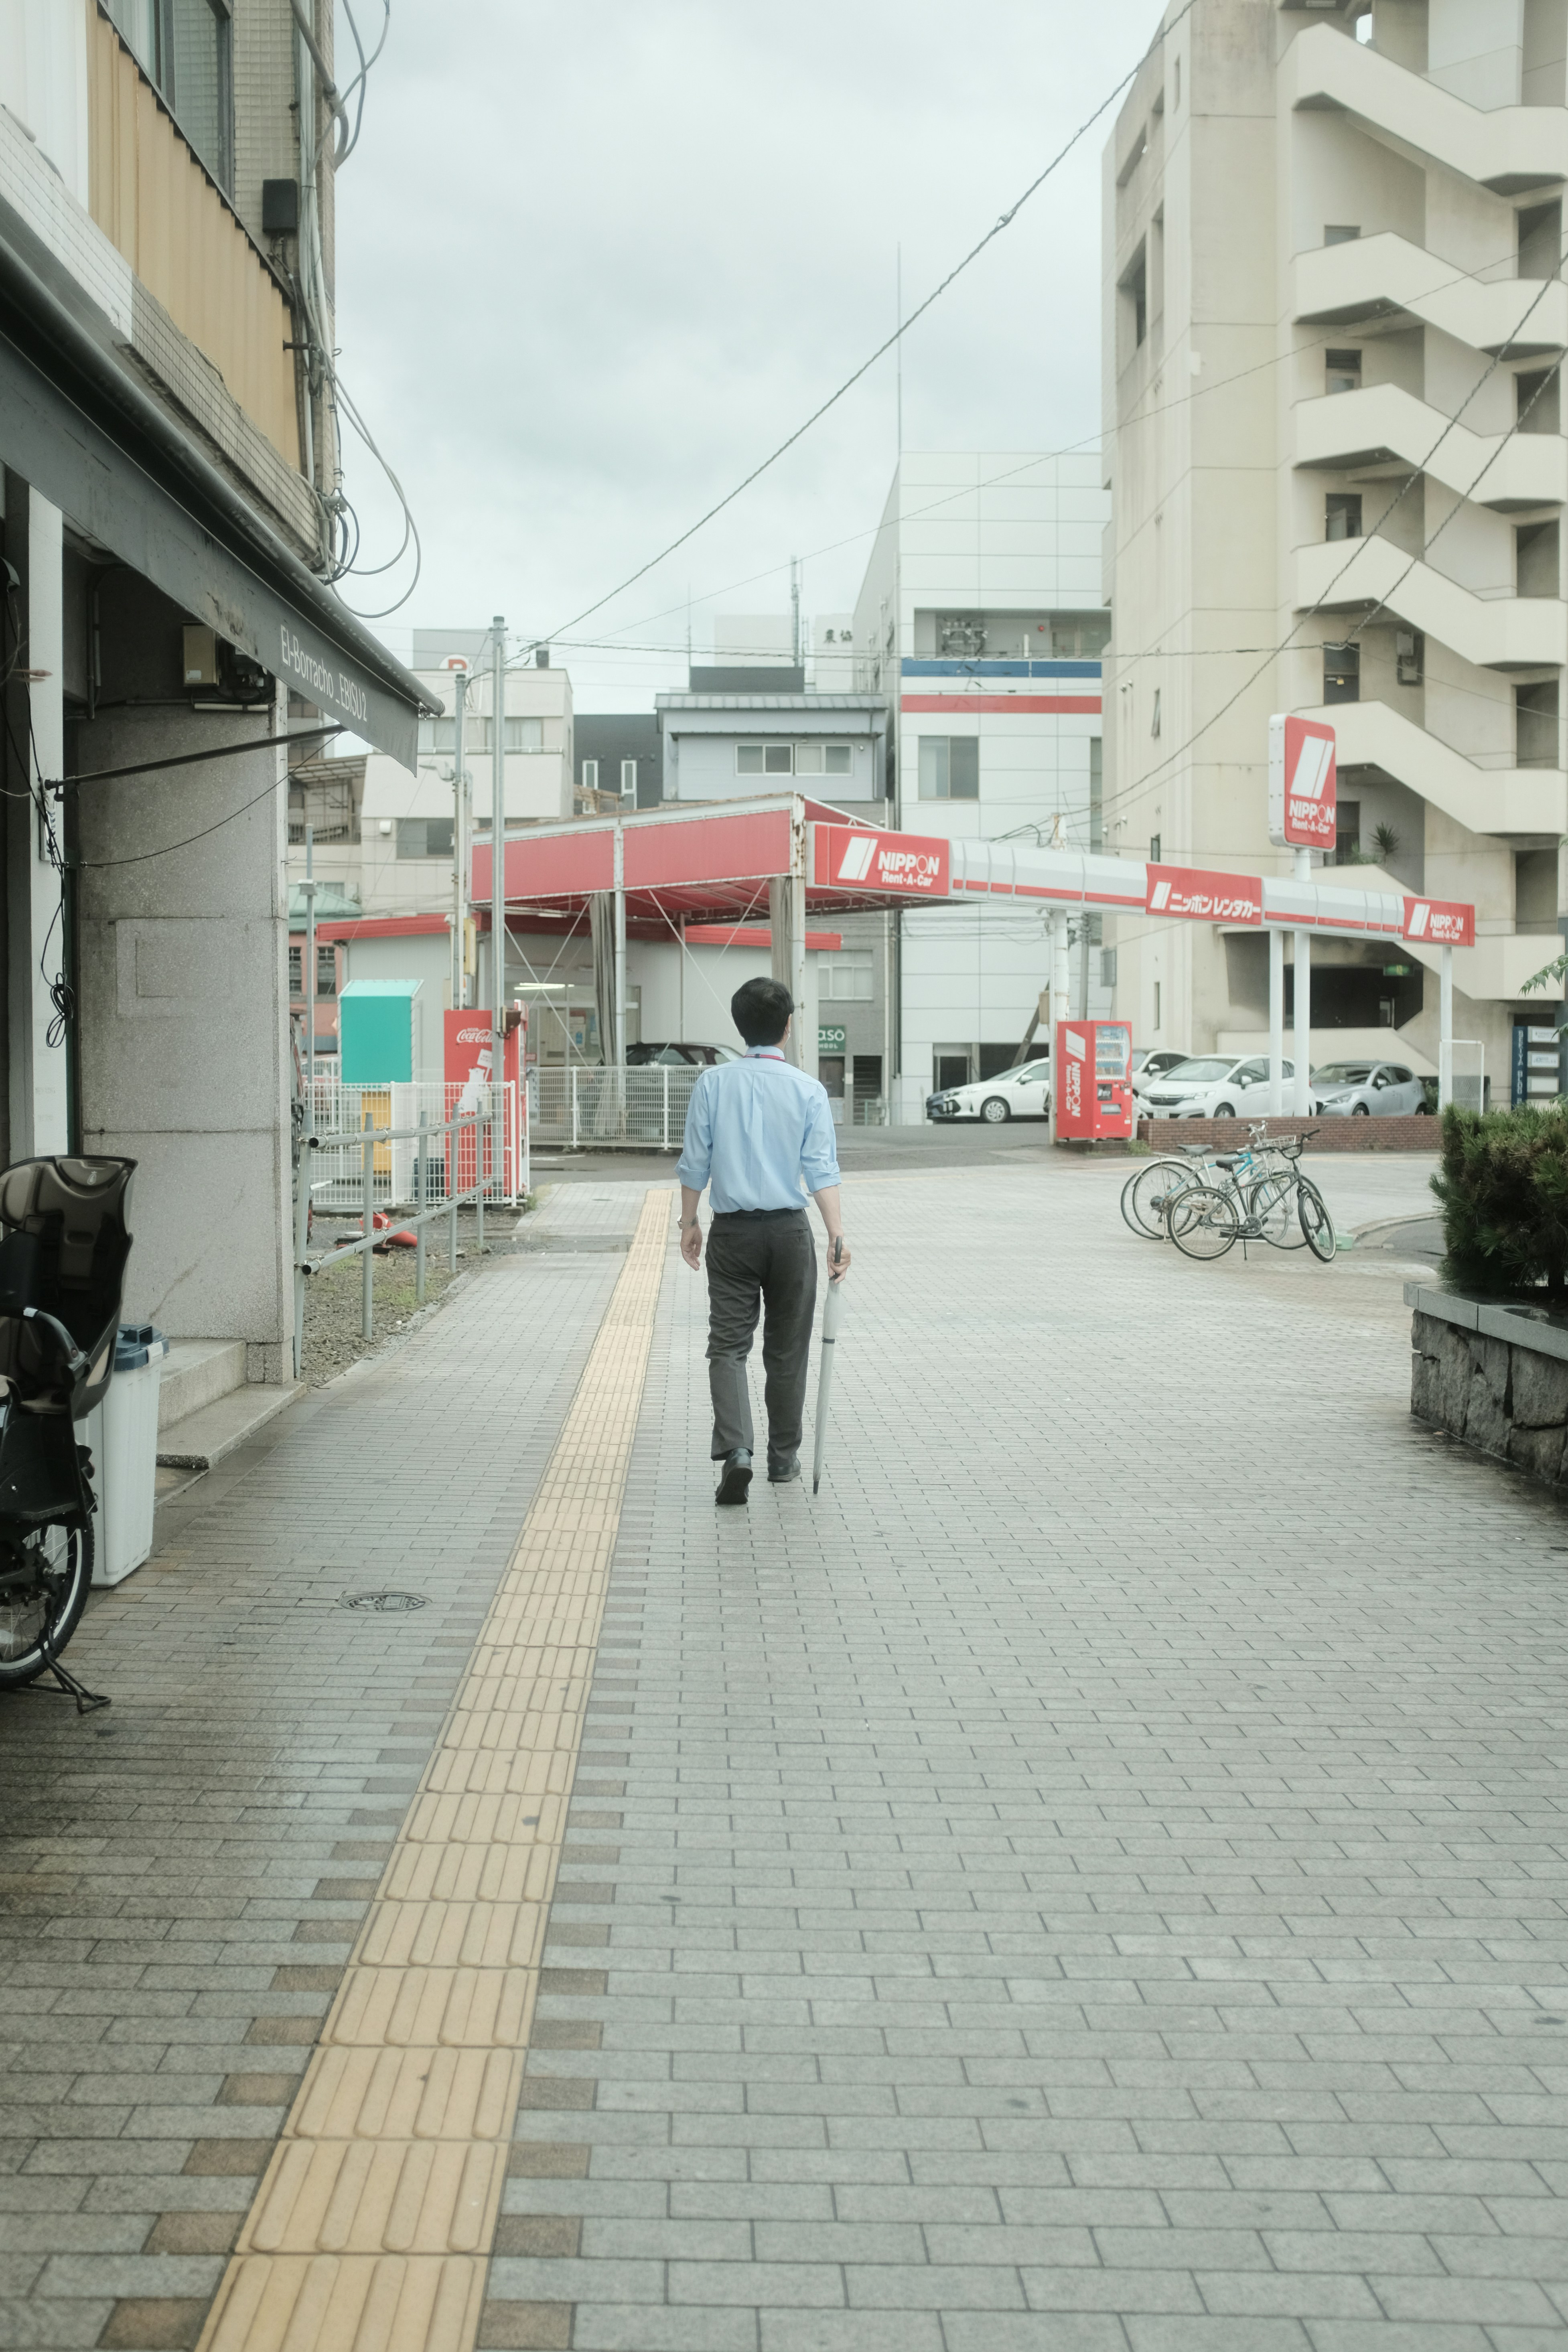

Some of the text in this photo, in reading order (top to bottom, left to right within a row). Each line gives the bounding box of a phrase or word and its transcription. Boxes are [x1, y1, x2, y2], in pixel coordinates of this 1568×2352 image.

[1289, 799, 1335, 824] NIPPON
[878, 851, 939, 875] NIPPON
[1169, 893, 1261, 918] ニッポンレンタカー
[1430, 913, 1463, 931] NIPPON
[1071, 1061, 1081, 1117] NIPPON
